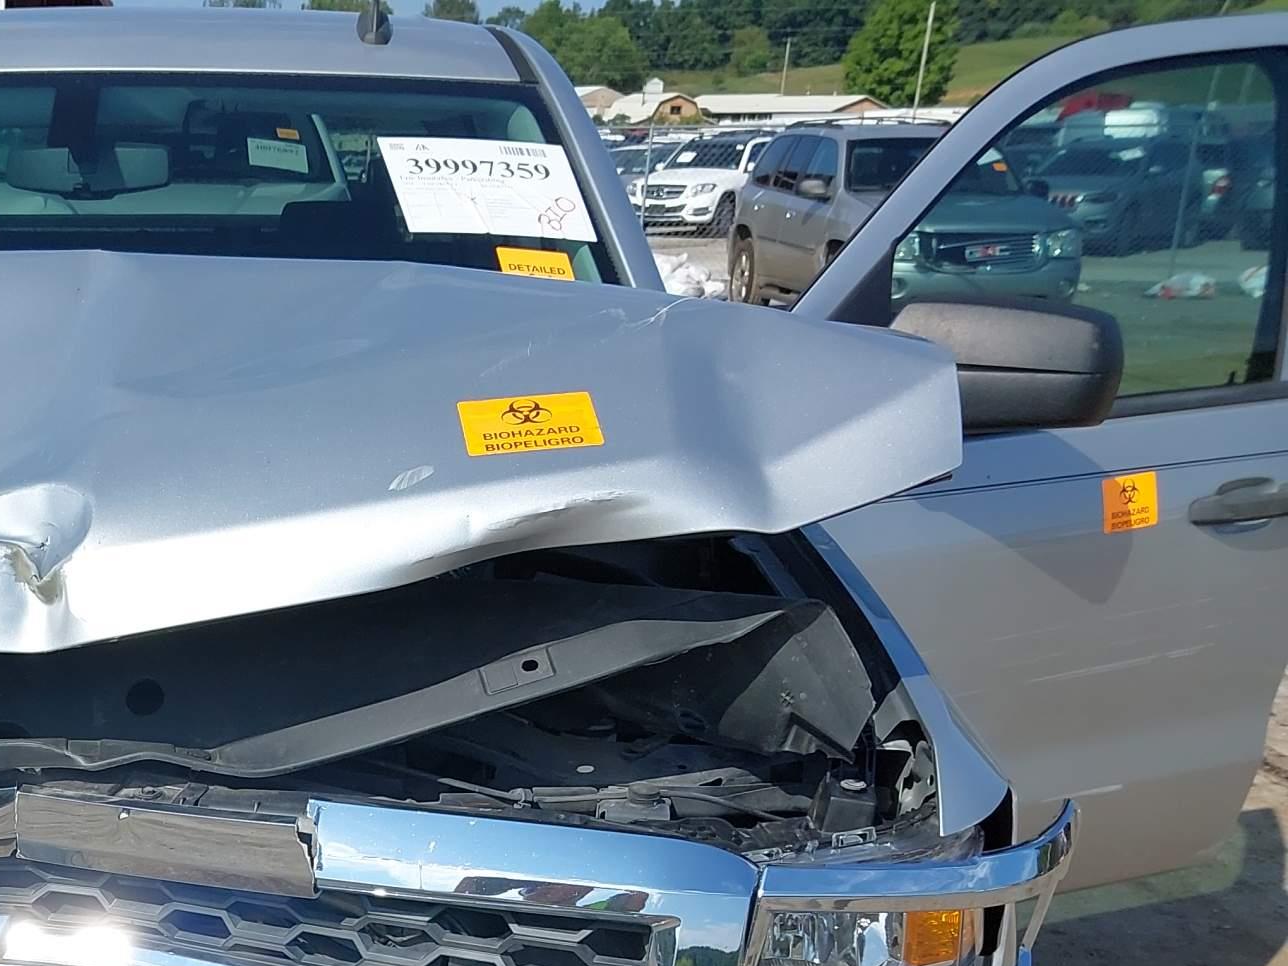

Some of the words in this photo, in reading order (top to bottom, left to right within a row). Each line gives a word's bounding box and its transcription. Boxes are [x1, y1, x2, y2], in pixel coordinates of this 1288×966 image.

[406, 158, 551, 180] 39997359
[508, 262, 566, 276] DETAILED
[482, 425, 581, 441] BIOHAZARD
[484, 435, 585, 452] BIOPELIGRO
